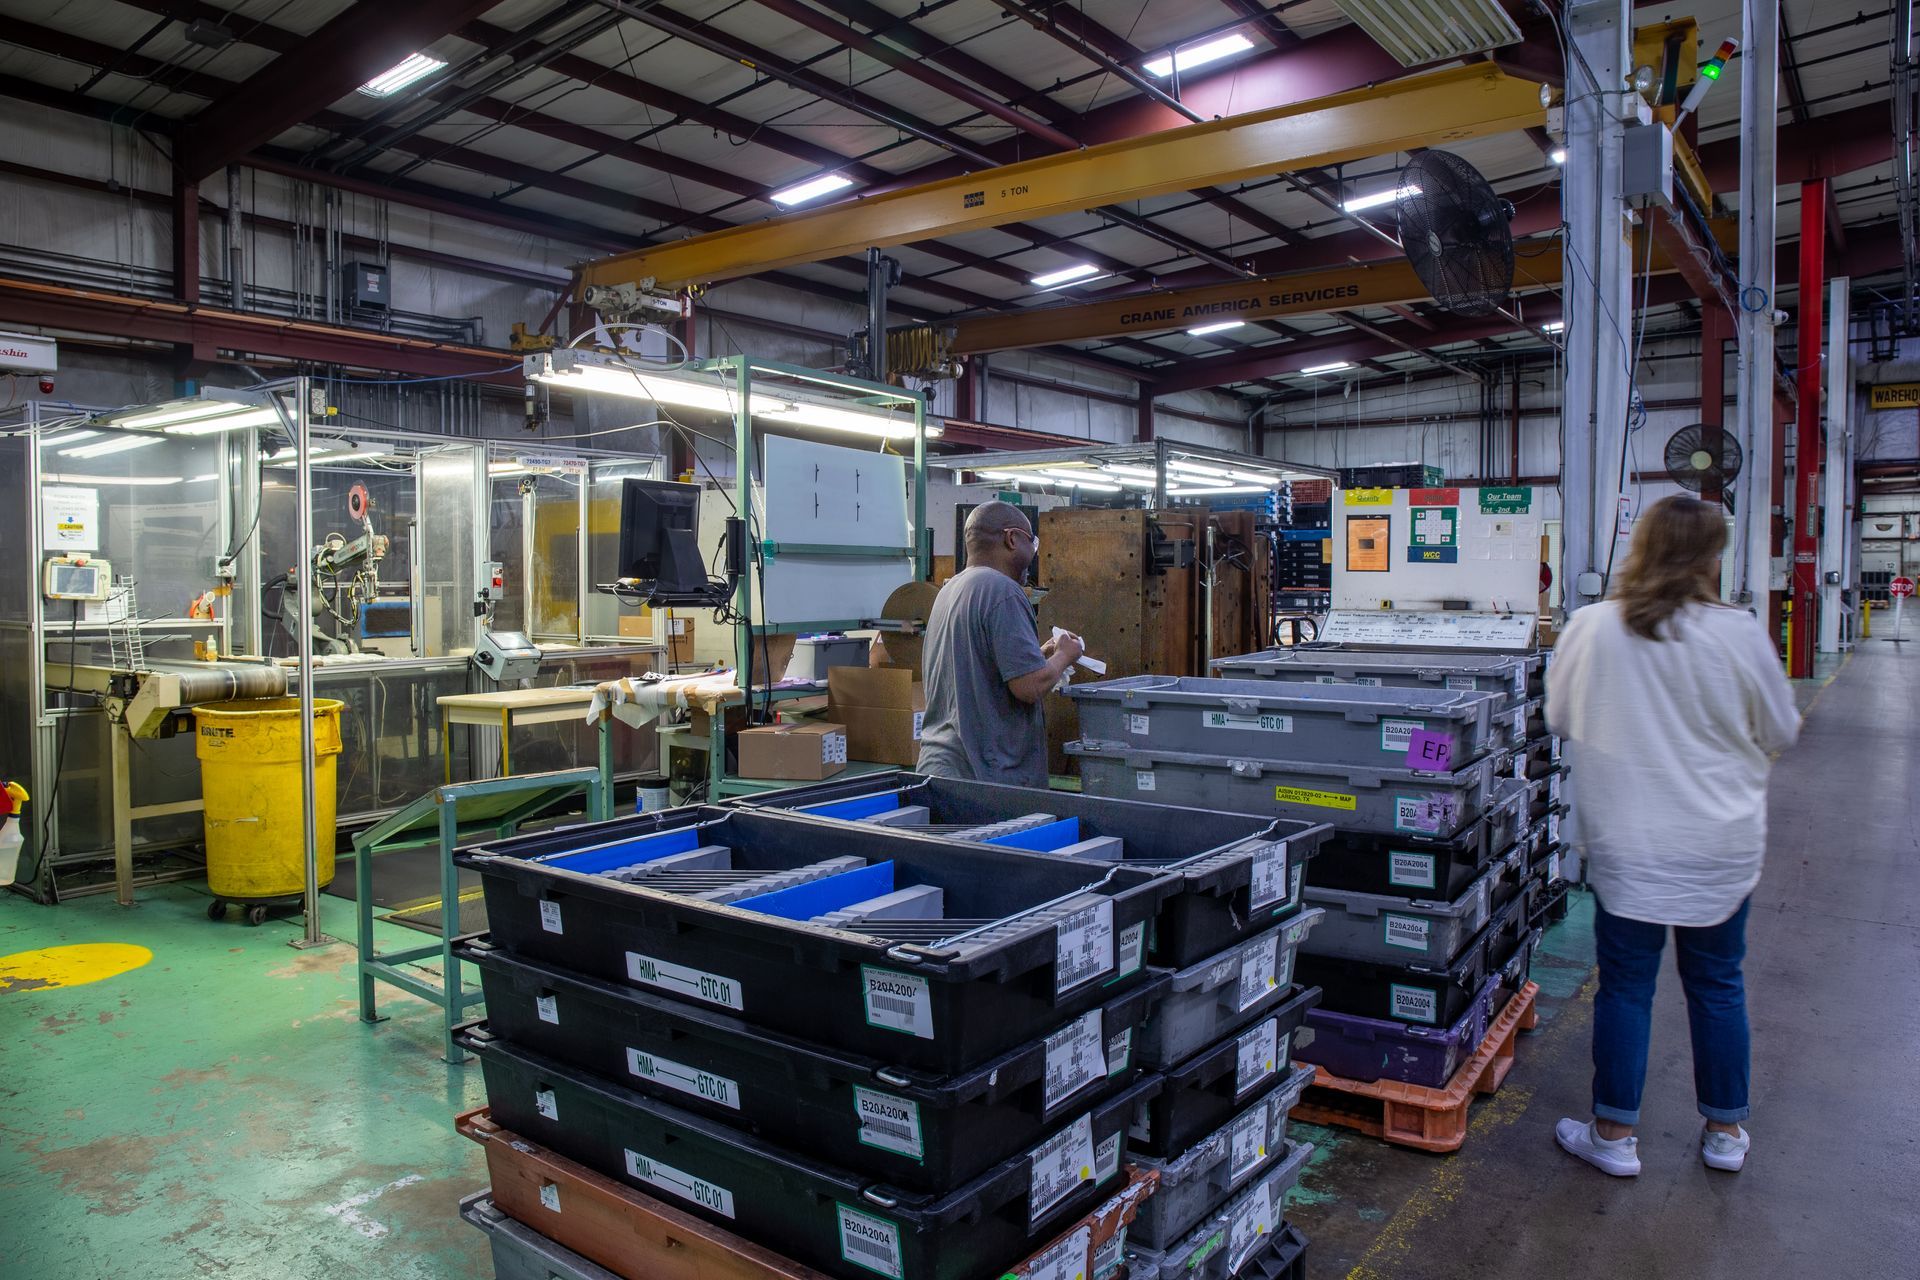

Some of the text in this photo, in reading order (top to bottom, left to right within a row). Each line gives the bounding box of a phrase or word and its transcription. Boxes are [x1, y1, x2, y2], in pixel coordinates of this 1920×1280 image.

[1001, 185, 1029, 198] 5 TON
[1120, 285, 1359, 325] CRANE AMERICA SERVICES
[0, 348, 28, 358] shin
[1874, 388, 1920, 403] WAREHO
[1487, 493, 1522, 501] Our Team
[1423, 551, 1440, 559] WCC
[1891, 582, 1913, 592] STOP
[1211, 713, 1284, 730] HMA GTC 01
[201, 726, 235, 738] BRUTE
[1385, 726, 1411, 735] B20A20
[1394, 858, 1428, 868] B20A2004
[1389, 921, 1423, 932] B20A2004
[1120, 930, 1139, 946] A2004
[639, 958, 731, 1003] HMA GTC 01
[1396, 994, 1430, 1008] B20A2004
[637, 1054, 728, 1101] HMA GTC 01
[635, 1156, 724, 1211] HMA GTC 01
[844, 1218, 890, 1245] B20A2004
